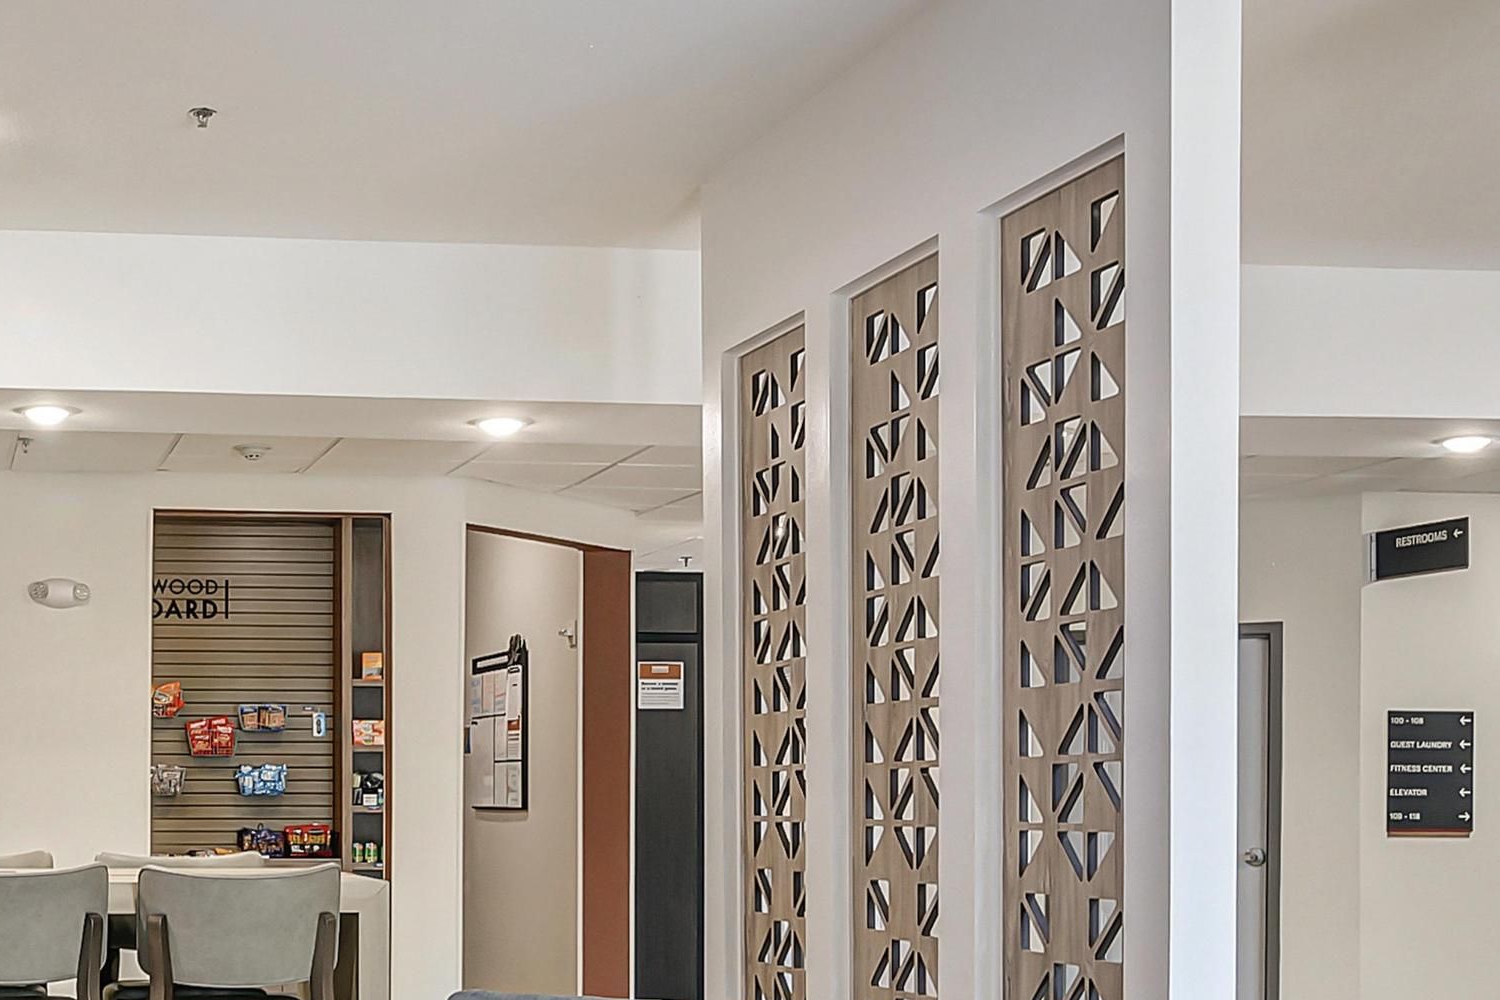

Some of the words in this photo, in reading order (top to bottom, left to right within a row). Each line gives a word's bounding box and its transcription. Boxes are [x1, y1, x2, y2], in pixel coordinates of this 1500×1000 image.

[1395, 530, 1448, 548] RESTROOMS
[1390, 740, 1415, 749] GUEST
[1416, 740, 1453, 749] LAUNDRY
[1390, 764, 1421, 773] FITNESS
[1422, 764, 1453, 773] CENTER
[1389, 788, 1428, 797] ELEVATOR
